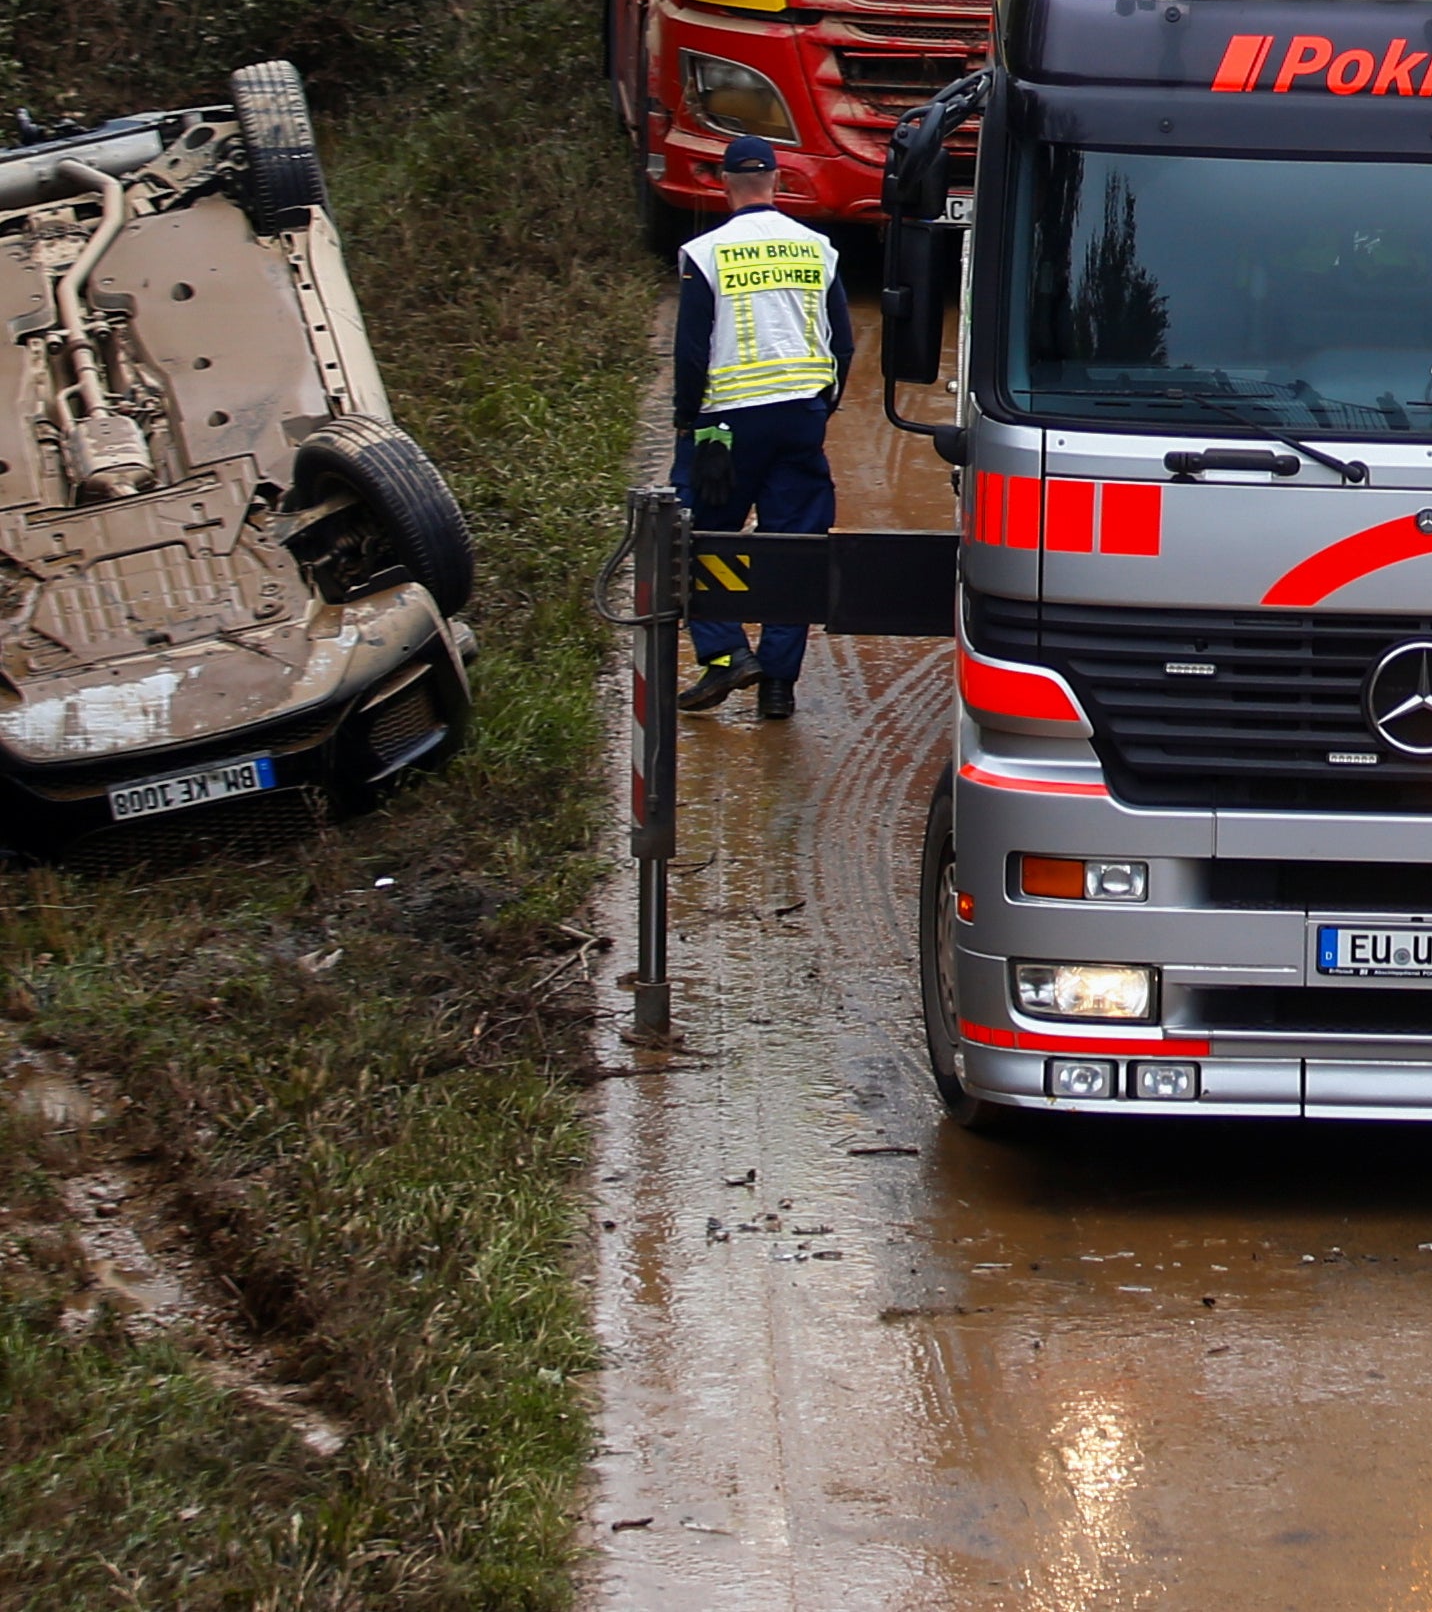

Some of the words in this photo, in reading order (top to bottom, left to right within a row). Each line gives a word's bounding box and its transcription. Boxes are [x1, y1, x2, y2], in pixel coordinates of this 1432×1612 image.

[720, 247, 760, 262] THW
[766, 242, 820, 259] BRÜHL
[725, 267, 821, 289] ZUGFÜHRER
[115, 784, 174, 815] 1008
[178, 775, 210, 803] KE
[1350, 934, 1391, 964] EU
